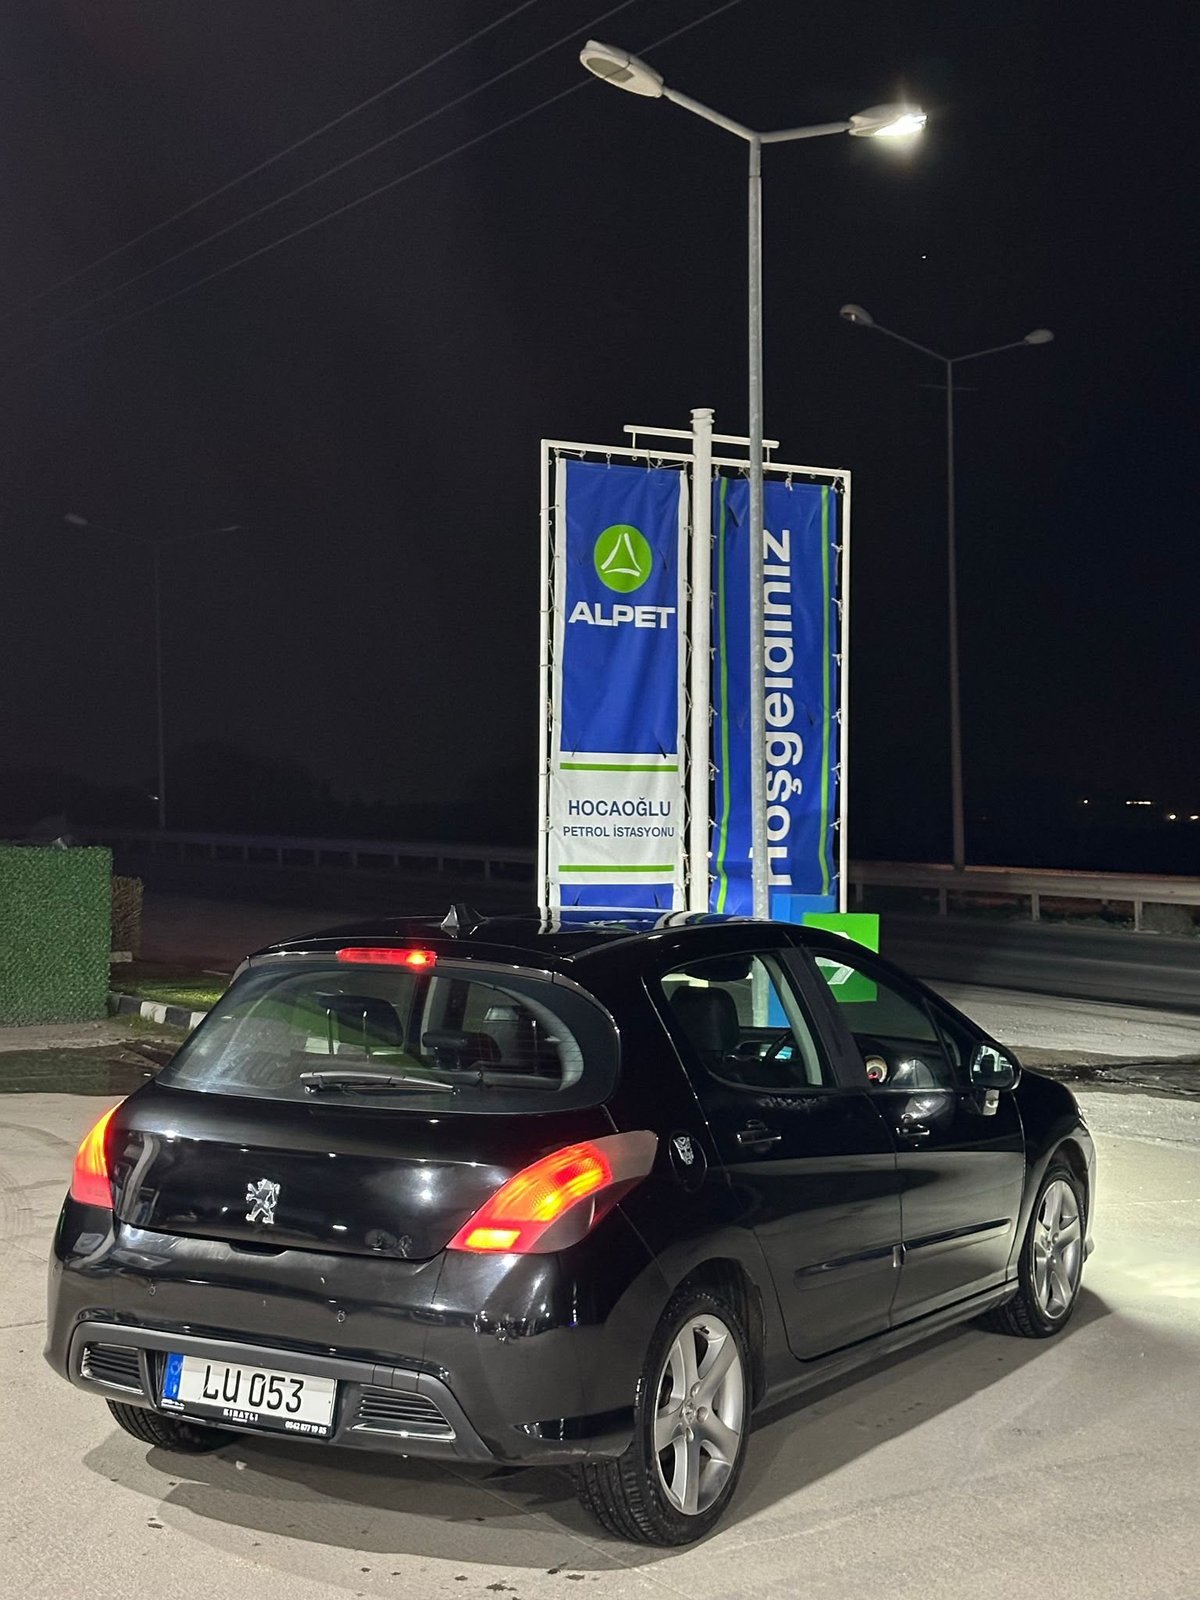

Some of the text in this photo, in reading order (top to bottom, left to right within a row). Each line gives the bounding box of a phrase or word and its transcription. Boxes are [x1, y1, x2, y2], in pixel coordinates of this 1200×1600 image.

[568, 601, 676, 629] ALPET
[568, 797, 671, 817] HOCAOĞLU
[563, 824, 675, 838] PETROL İSTASYONU
[203, 1365, 305, 1413] LU 053
